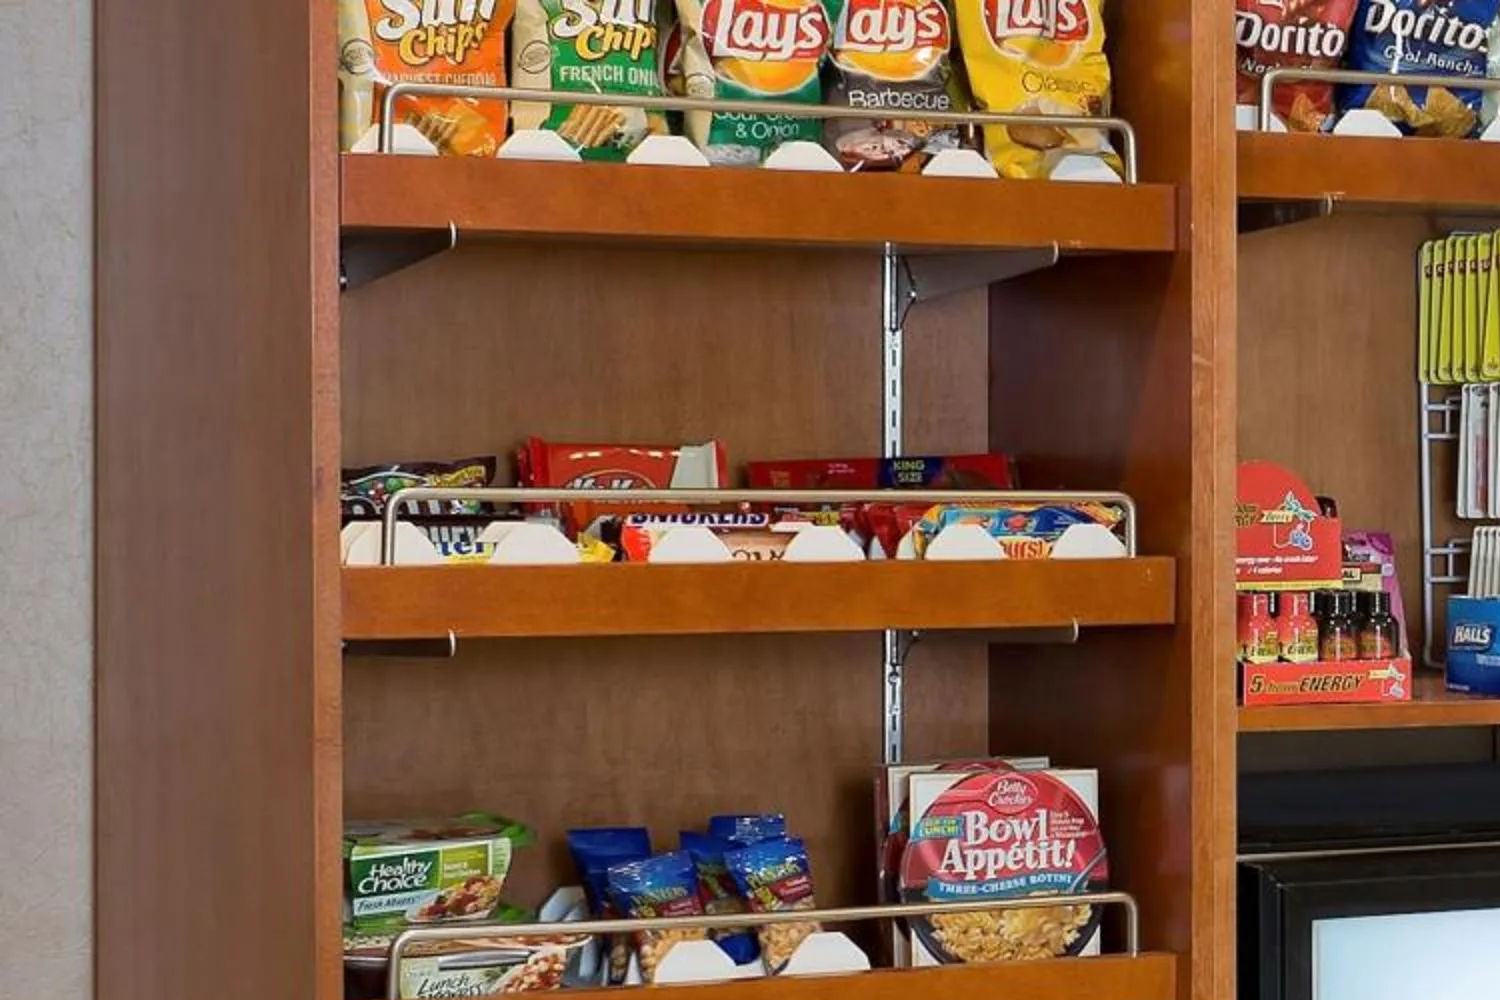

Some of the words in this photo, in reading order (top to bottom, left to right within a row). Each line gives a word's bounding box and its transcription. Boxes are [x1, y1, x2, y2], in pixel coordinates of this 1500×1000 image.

[996, 0, 1078, 38] Lays
[400, 24, 488, 65] Chips
[576, 23, 657, 60] Chip
[1236, 11, 1345, 57] Dorito
[560, 64, 623, 82] FRENCH
[1426, 53, 1477, 76] Ranch
[848, 88, 949, 111] Barbecue
[735, 122, 748, 138] &
[752, 121, 799, 139] Onion
[893, 460, 925, 471] KING
[898, 472, 922, 483] SIZE
[1454, 624, 1492, 644] HALLS
[1250, 674, 1264, 692] 5
[1299, 674, 1363, 693] ENERGY
[996, 779, 1025, 796] Betty
[962, 808, 1048, 846] Bowl
[371, 857, 432, 878] Healthy
[937, 838, 1077, 881] Appétit!
[358, 873, 428, 894] Choice
[938, 876, 1028, 894] THREE-CHEESE
